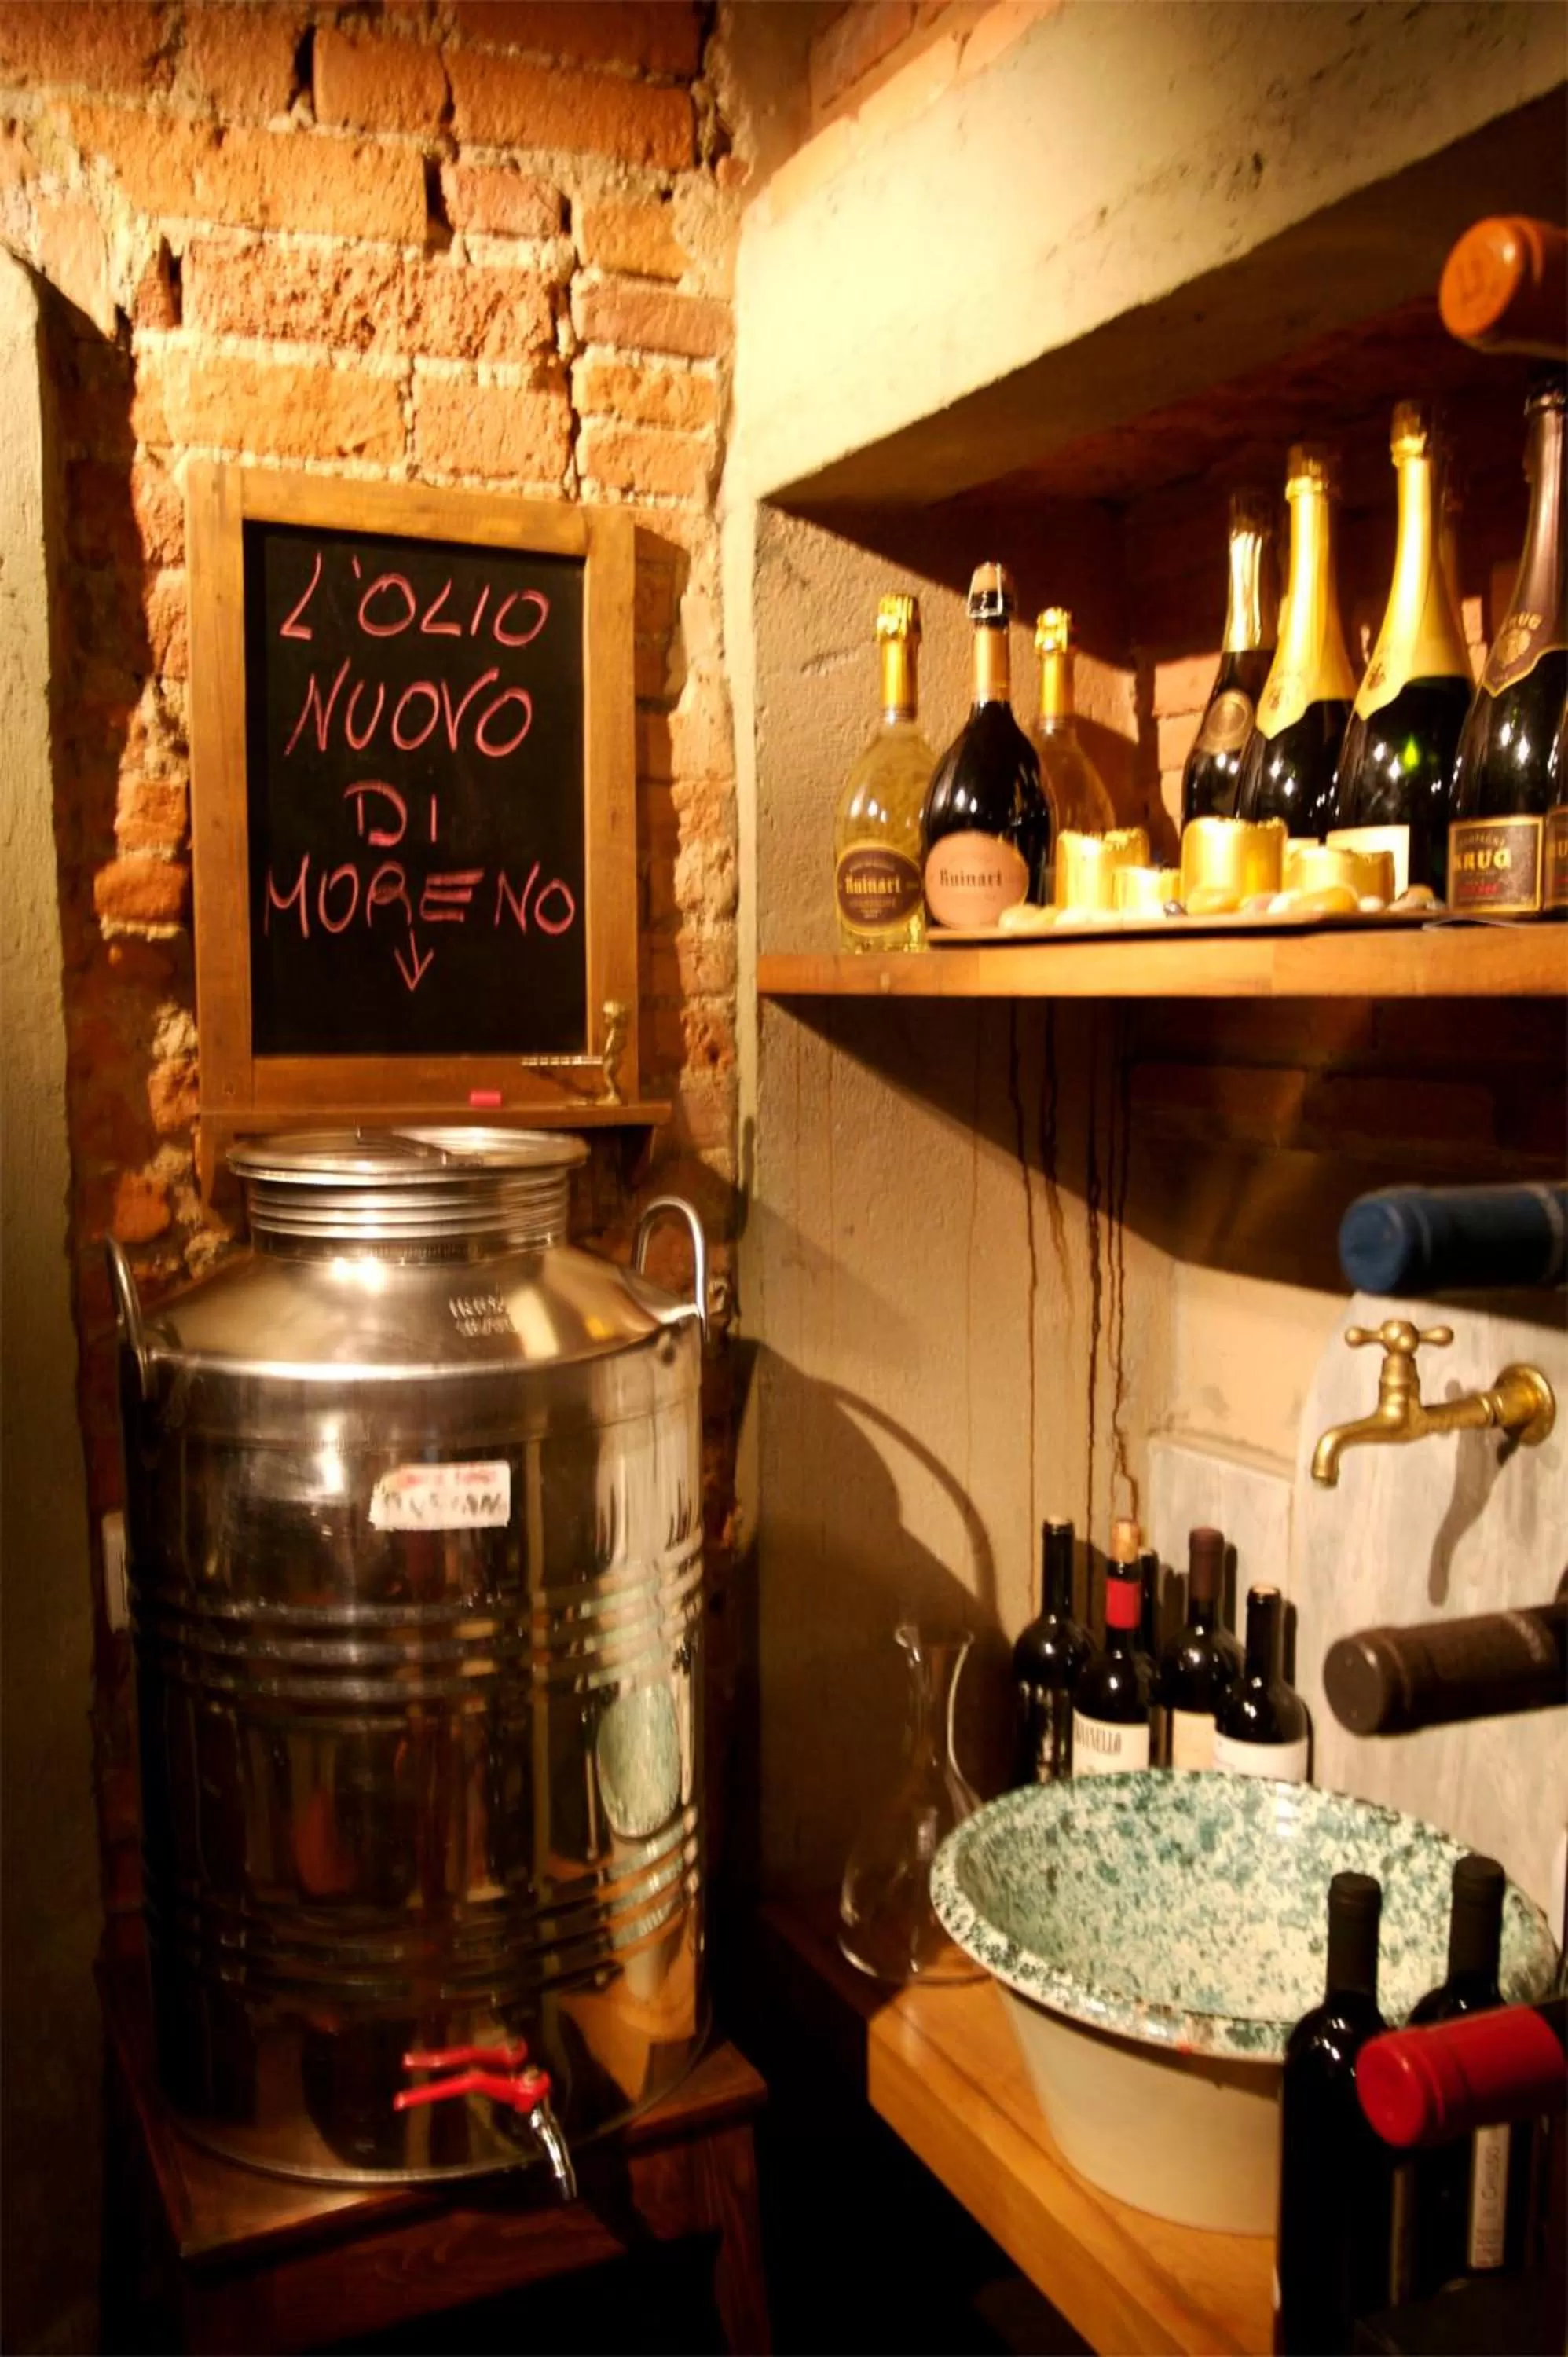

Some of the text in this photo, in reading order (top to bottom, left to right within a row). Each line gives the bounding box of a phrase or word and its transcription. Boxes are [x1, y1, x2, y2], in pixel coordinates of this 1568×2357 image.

[280, 549, 551, 647] L'OLIO
[284, 657, 533, 757] NUOVO
[343, 779, 438, 847] DI
[263, 852, 575, 939] MORENO
[845, 872, 902, 893] Ruinart
[939, 867, 1002, 888] Ruinart
